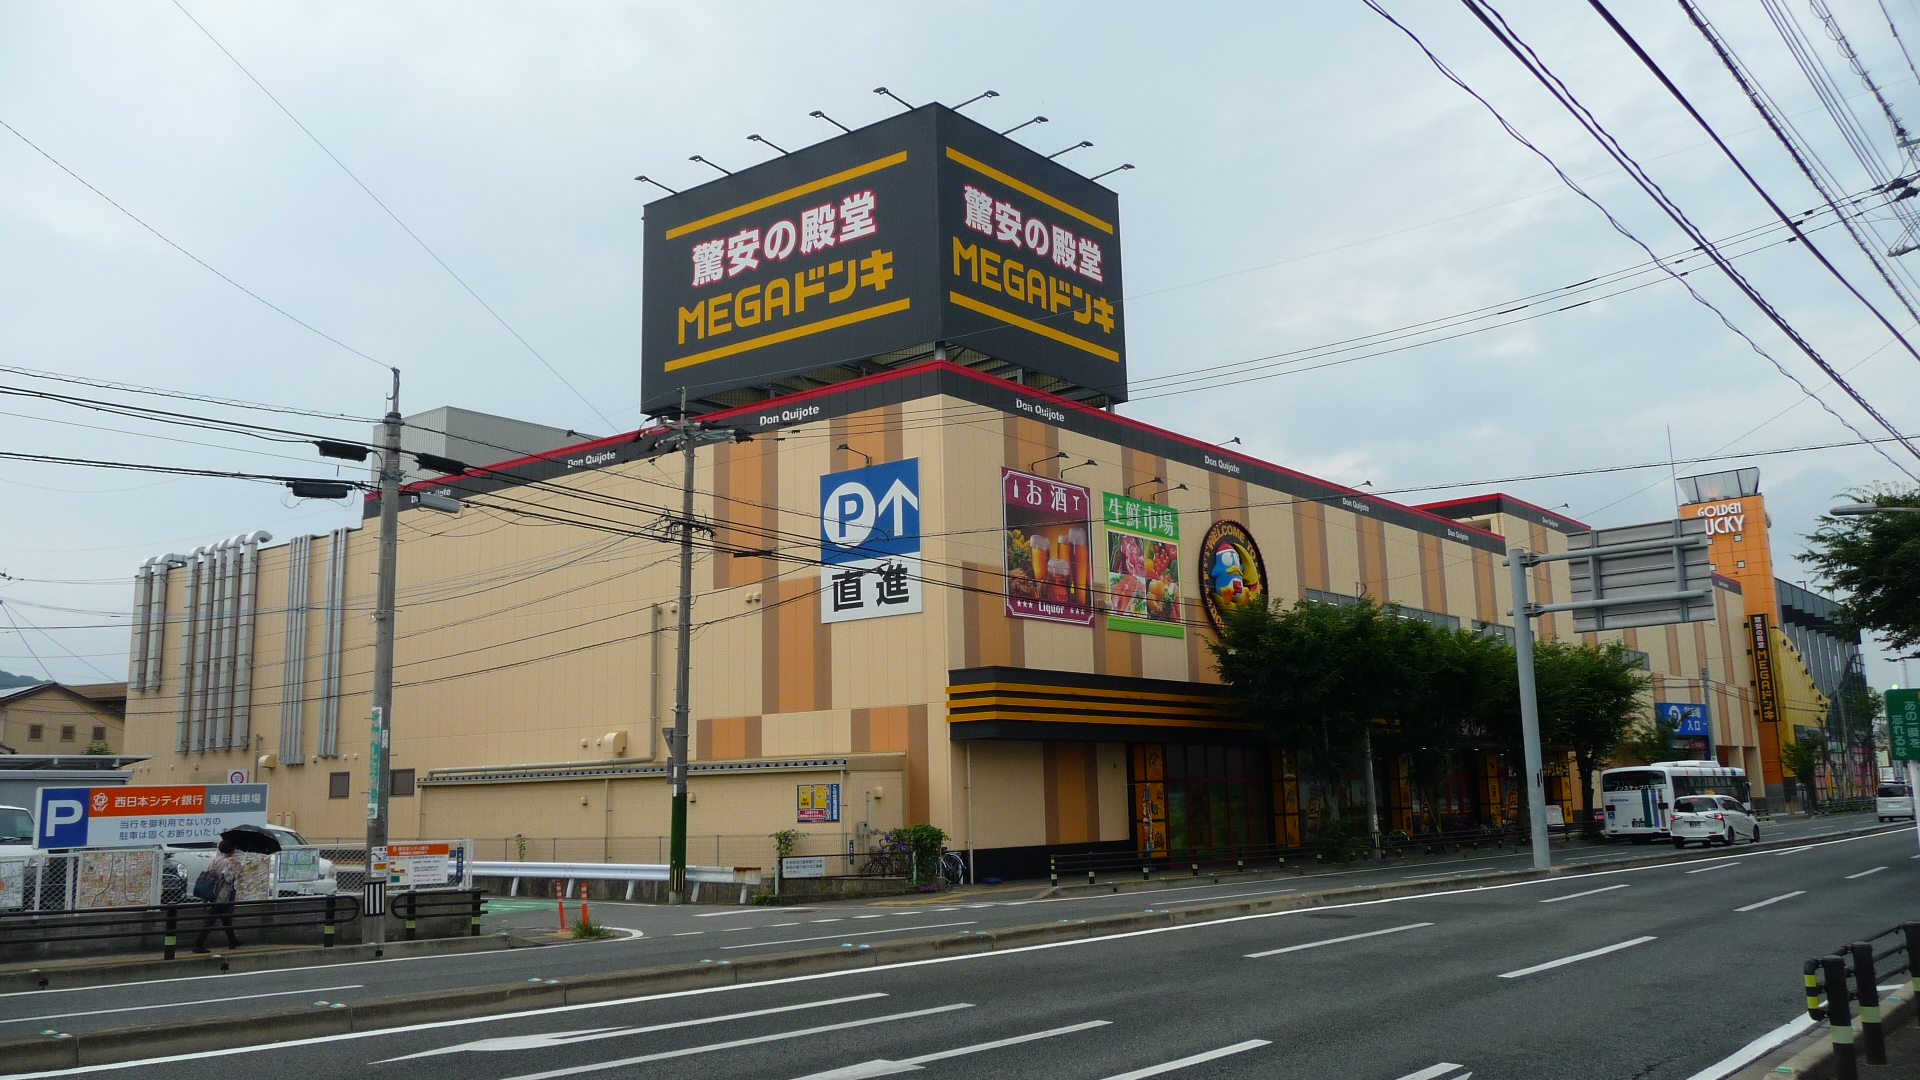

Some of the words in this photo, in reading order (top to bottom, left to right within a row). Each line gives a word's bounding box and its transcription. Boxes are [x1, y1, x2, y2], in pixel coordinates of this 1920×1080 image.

[692, 191, 877, 287] 驚安の殿堂
[964, 185, 1104, 282] 驚安の殿堂
[677, 248, 894, 345] MEGAドンキ
[952, 236, 1116, 335] MEGAドンキ
[760, 415, 780, 427] Don
[782, 405, 820, 421] Quijote
[1015, 397, 1034, 413] Don
[1035, 404, 1065, 423] Quijote
[567, 458, 584, 469] Don
[585, 450, 617, 466] Quijote
[1205, 455, 1217, 467] Don
[1218, 458, 1241, 474] Quijote
[1026, 479, 1067, 513] お酒
[1342, 497, 1353, 508] Don
[1353, 500, 1370, 513] Quijote
[838, 492, 864, 539] P
[1108, 497, 1174, 538] 生鮮市場
[1697, 502, 1742, 517] GOLDEN
[1447, 528, 1456, 537] Don
[1705, 514, 1745, 535] UCKY
[1208, 524, 1246, 550] WELCOME
[1246, 540, 1257, 561] TO
[831, 562, 910, 613] 直進
[1038, 601, 1065, 616] Liquor
[1757, 650, 1774, 720] MEGAドンキ
[1687, 720, 1701, 731] 入口
[1891, 714, 1908, 757] 忘れるな
[115, 795, 203, 807] 西日本シティ銀行
[209, 793, 261, 805] 専用駐車場
[46, 800, 83, 837] P
[119, 817, 222, 829] 当行を御利用でない方の
[119, 827, 228, 840] 駐車は固くお断りいたし
